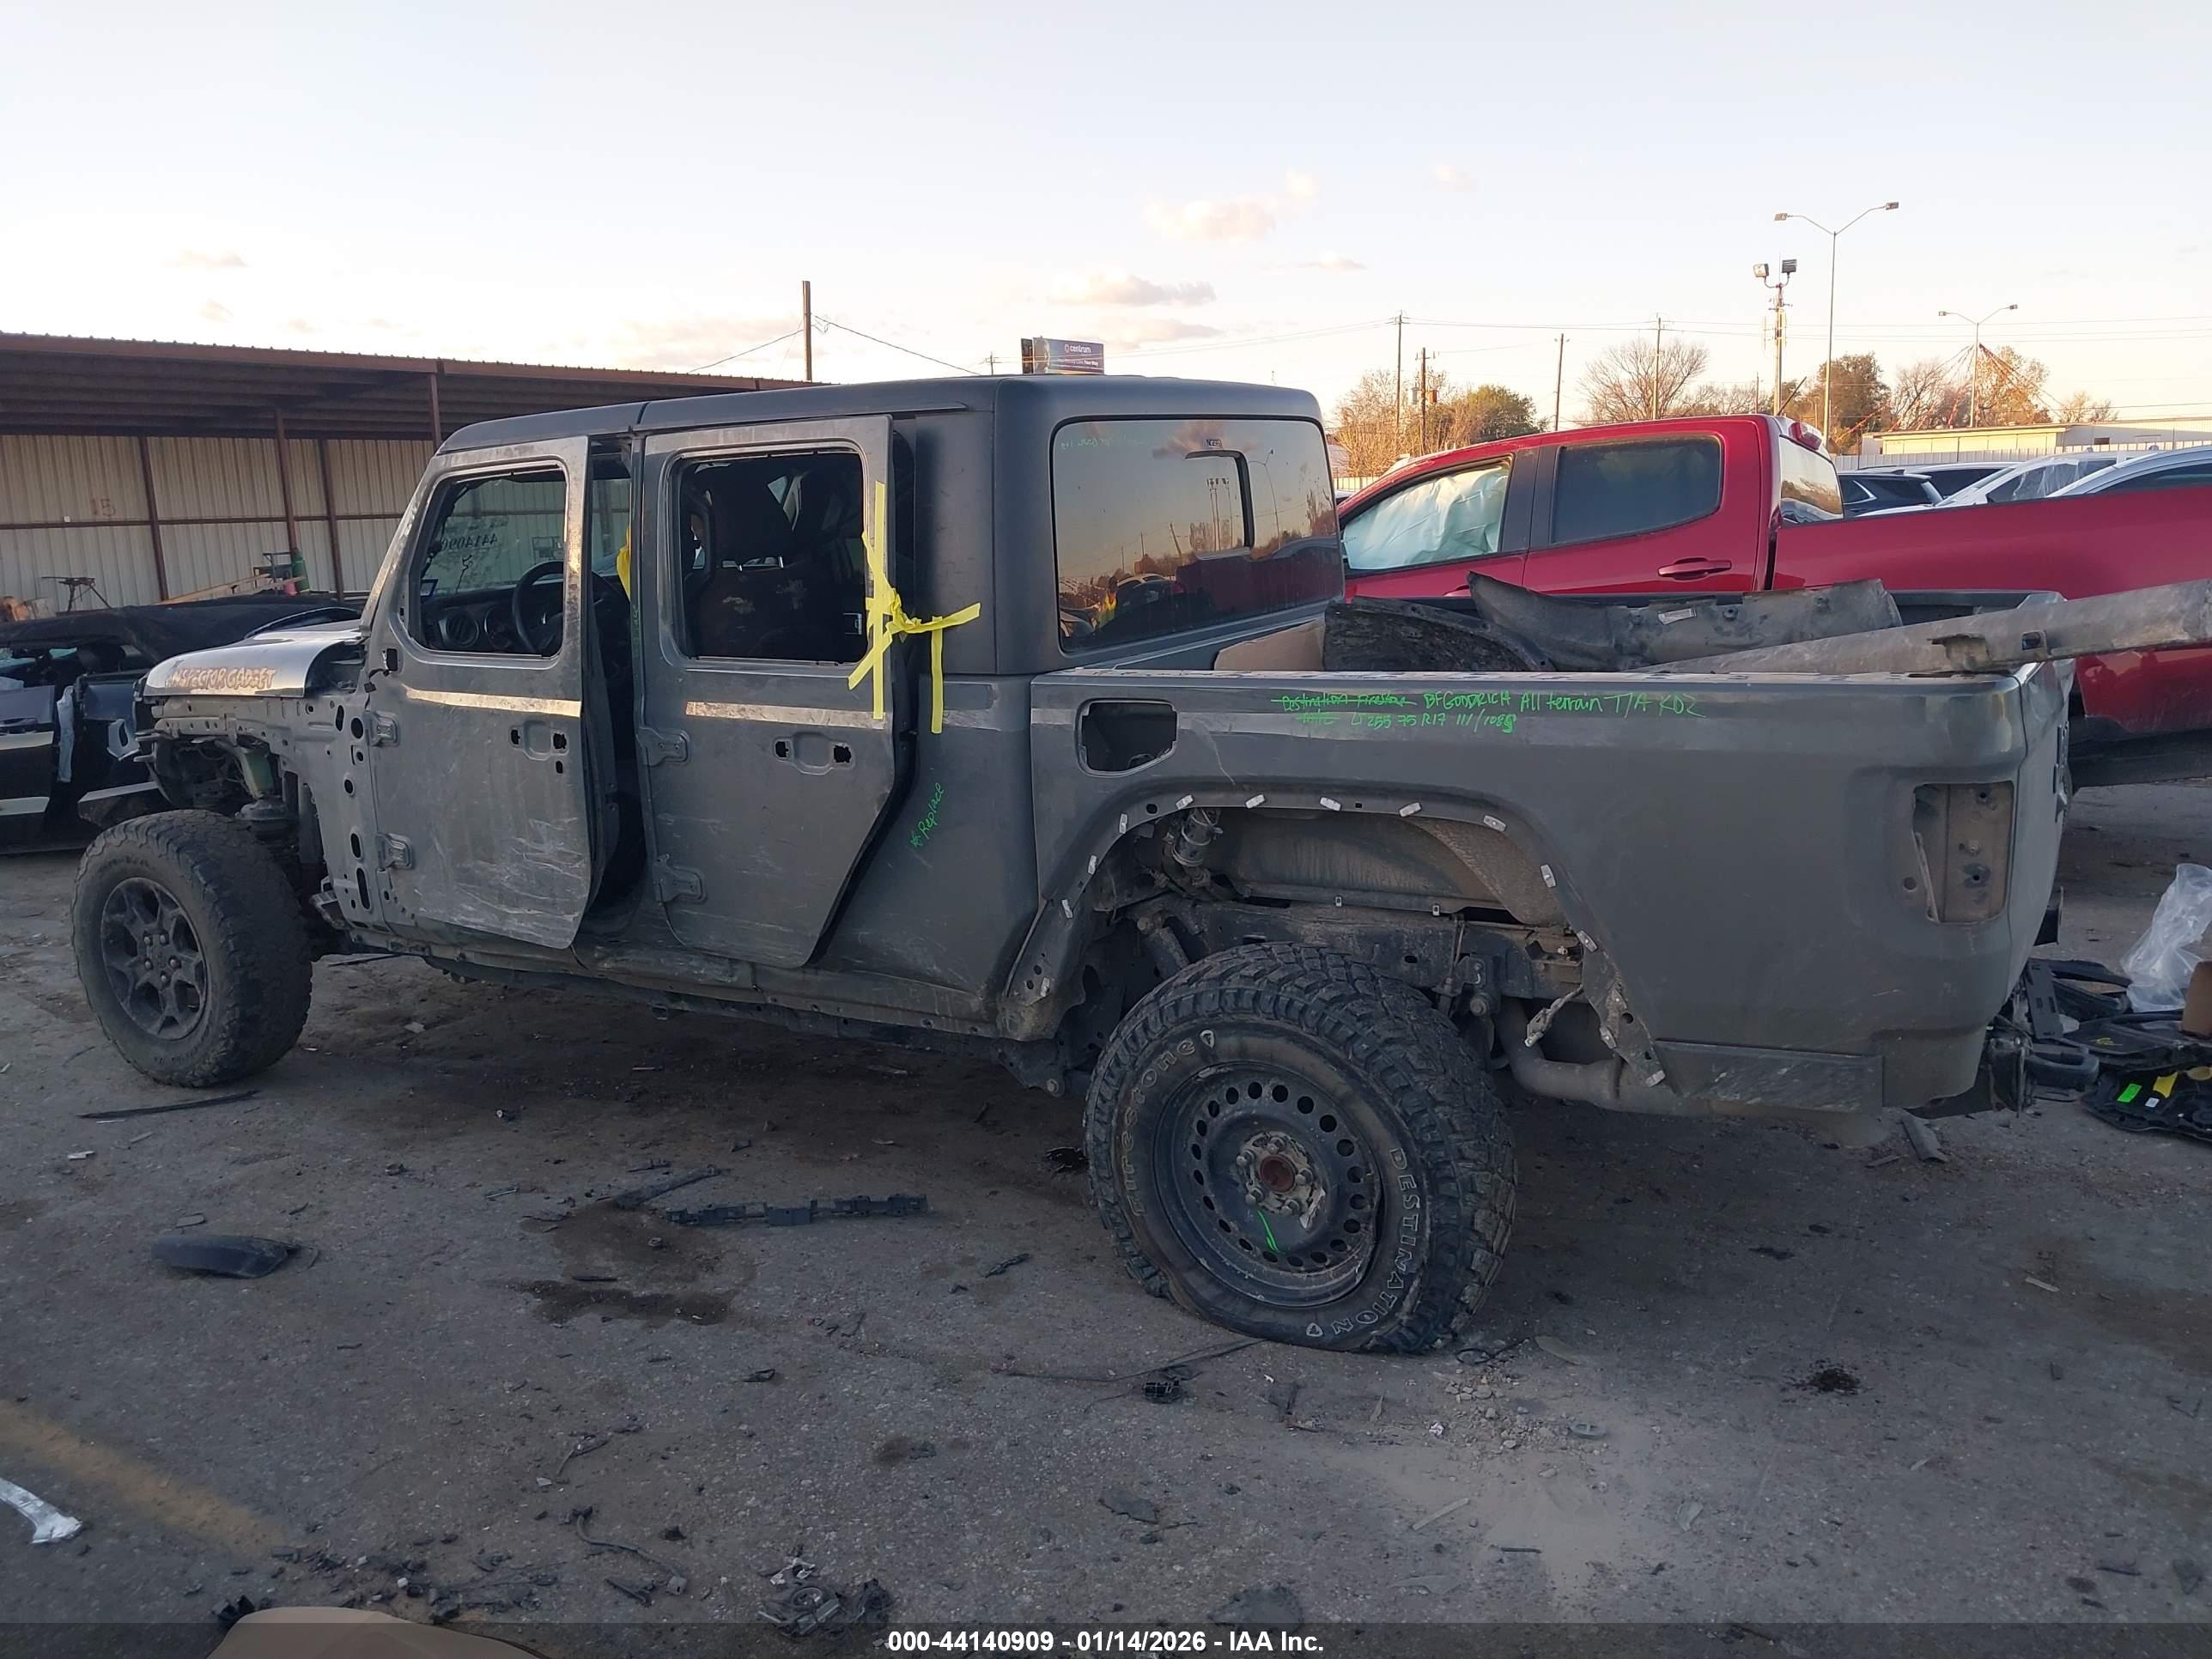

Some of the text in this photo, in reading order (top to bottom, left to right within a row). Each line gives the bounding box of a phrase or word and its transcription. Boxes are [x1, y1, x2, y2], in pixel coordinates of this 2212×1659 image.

[89, 498, 117, 516] 15
[225, 667, 276, 690] GADGET
[1603, 692, 1653, 719] T/A
[1421, 713, 1447, 726] R17
[918, 782, 945, 840] Replace
[1331, 1147, 1421, 1335] DESTINATION
